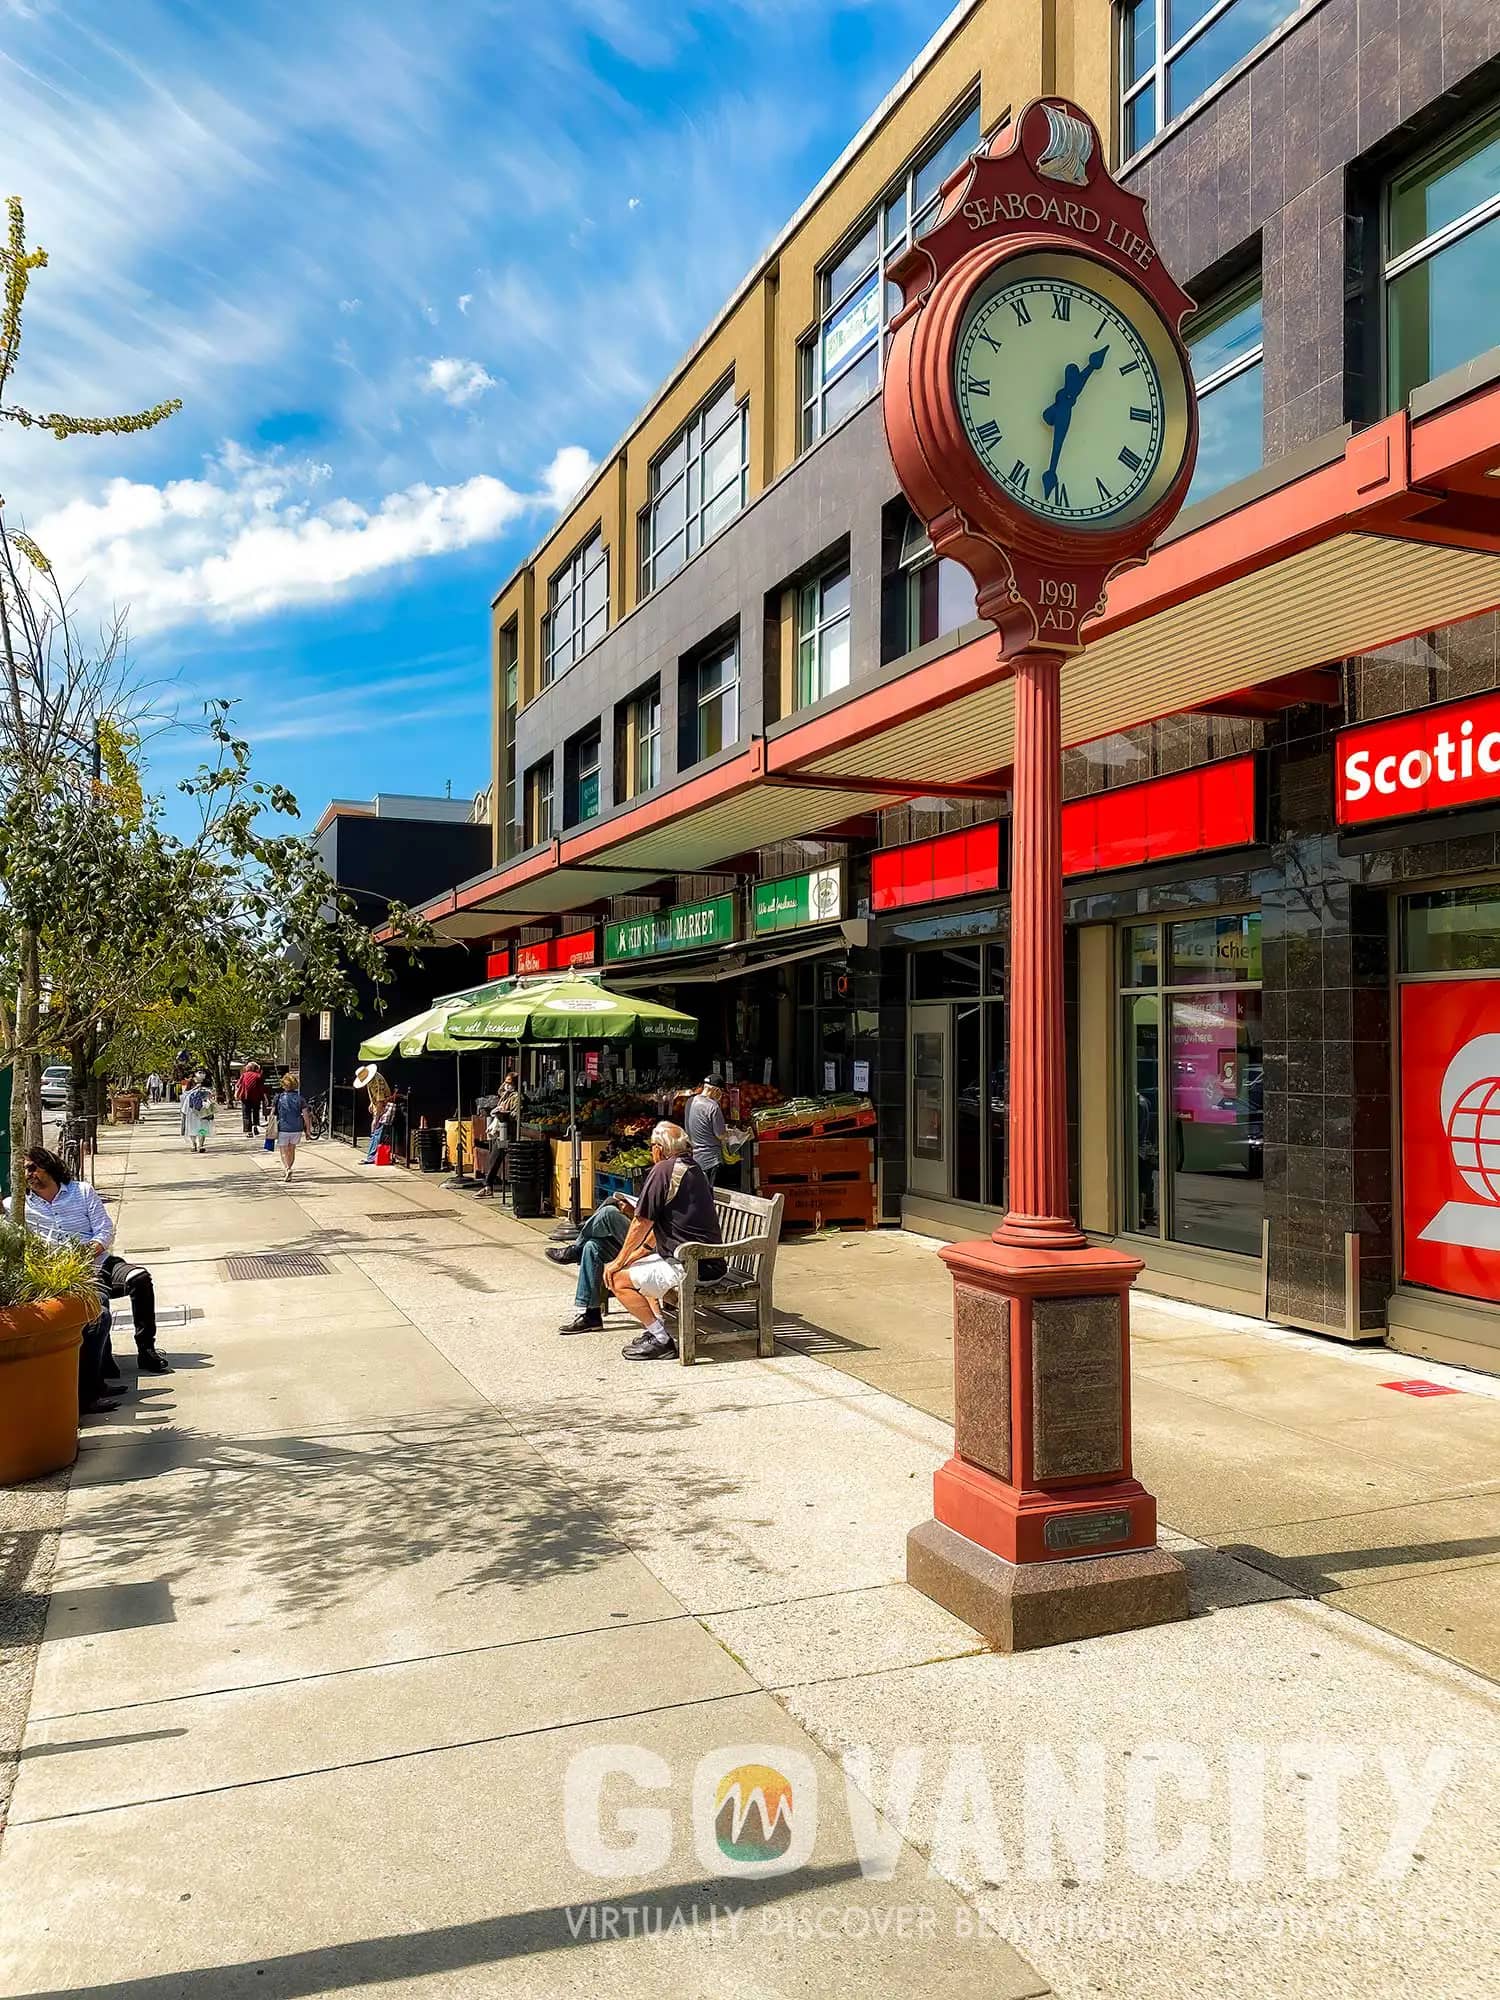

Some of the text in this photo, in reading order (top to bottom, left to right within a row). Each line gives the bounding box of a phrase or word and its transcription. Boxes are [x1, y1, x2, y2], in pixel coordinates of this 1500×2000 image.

[962, 193, 1156, 271] SEABOARD LIFE
[1009, 297, 1033, 327] XI
[1051, 293, 1072, 322] XII
[978, 327, 1002, 354] X
[1118, 359, 1141, 377] II
[1129, 406, 1152, 424] III
[1095, 476, 1113, 502] V
[1037, 578, 1079, 610] 1991
[1039, 607, 1075, 632] AD
[628, 924, 649, 949] KIN'S
[675, 909, 715, 940] MARKET
[1209, 939, 1258, 959] richer
